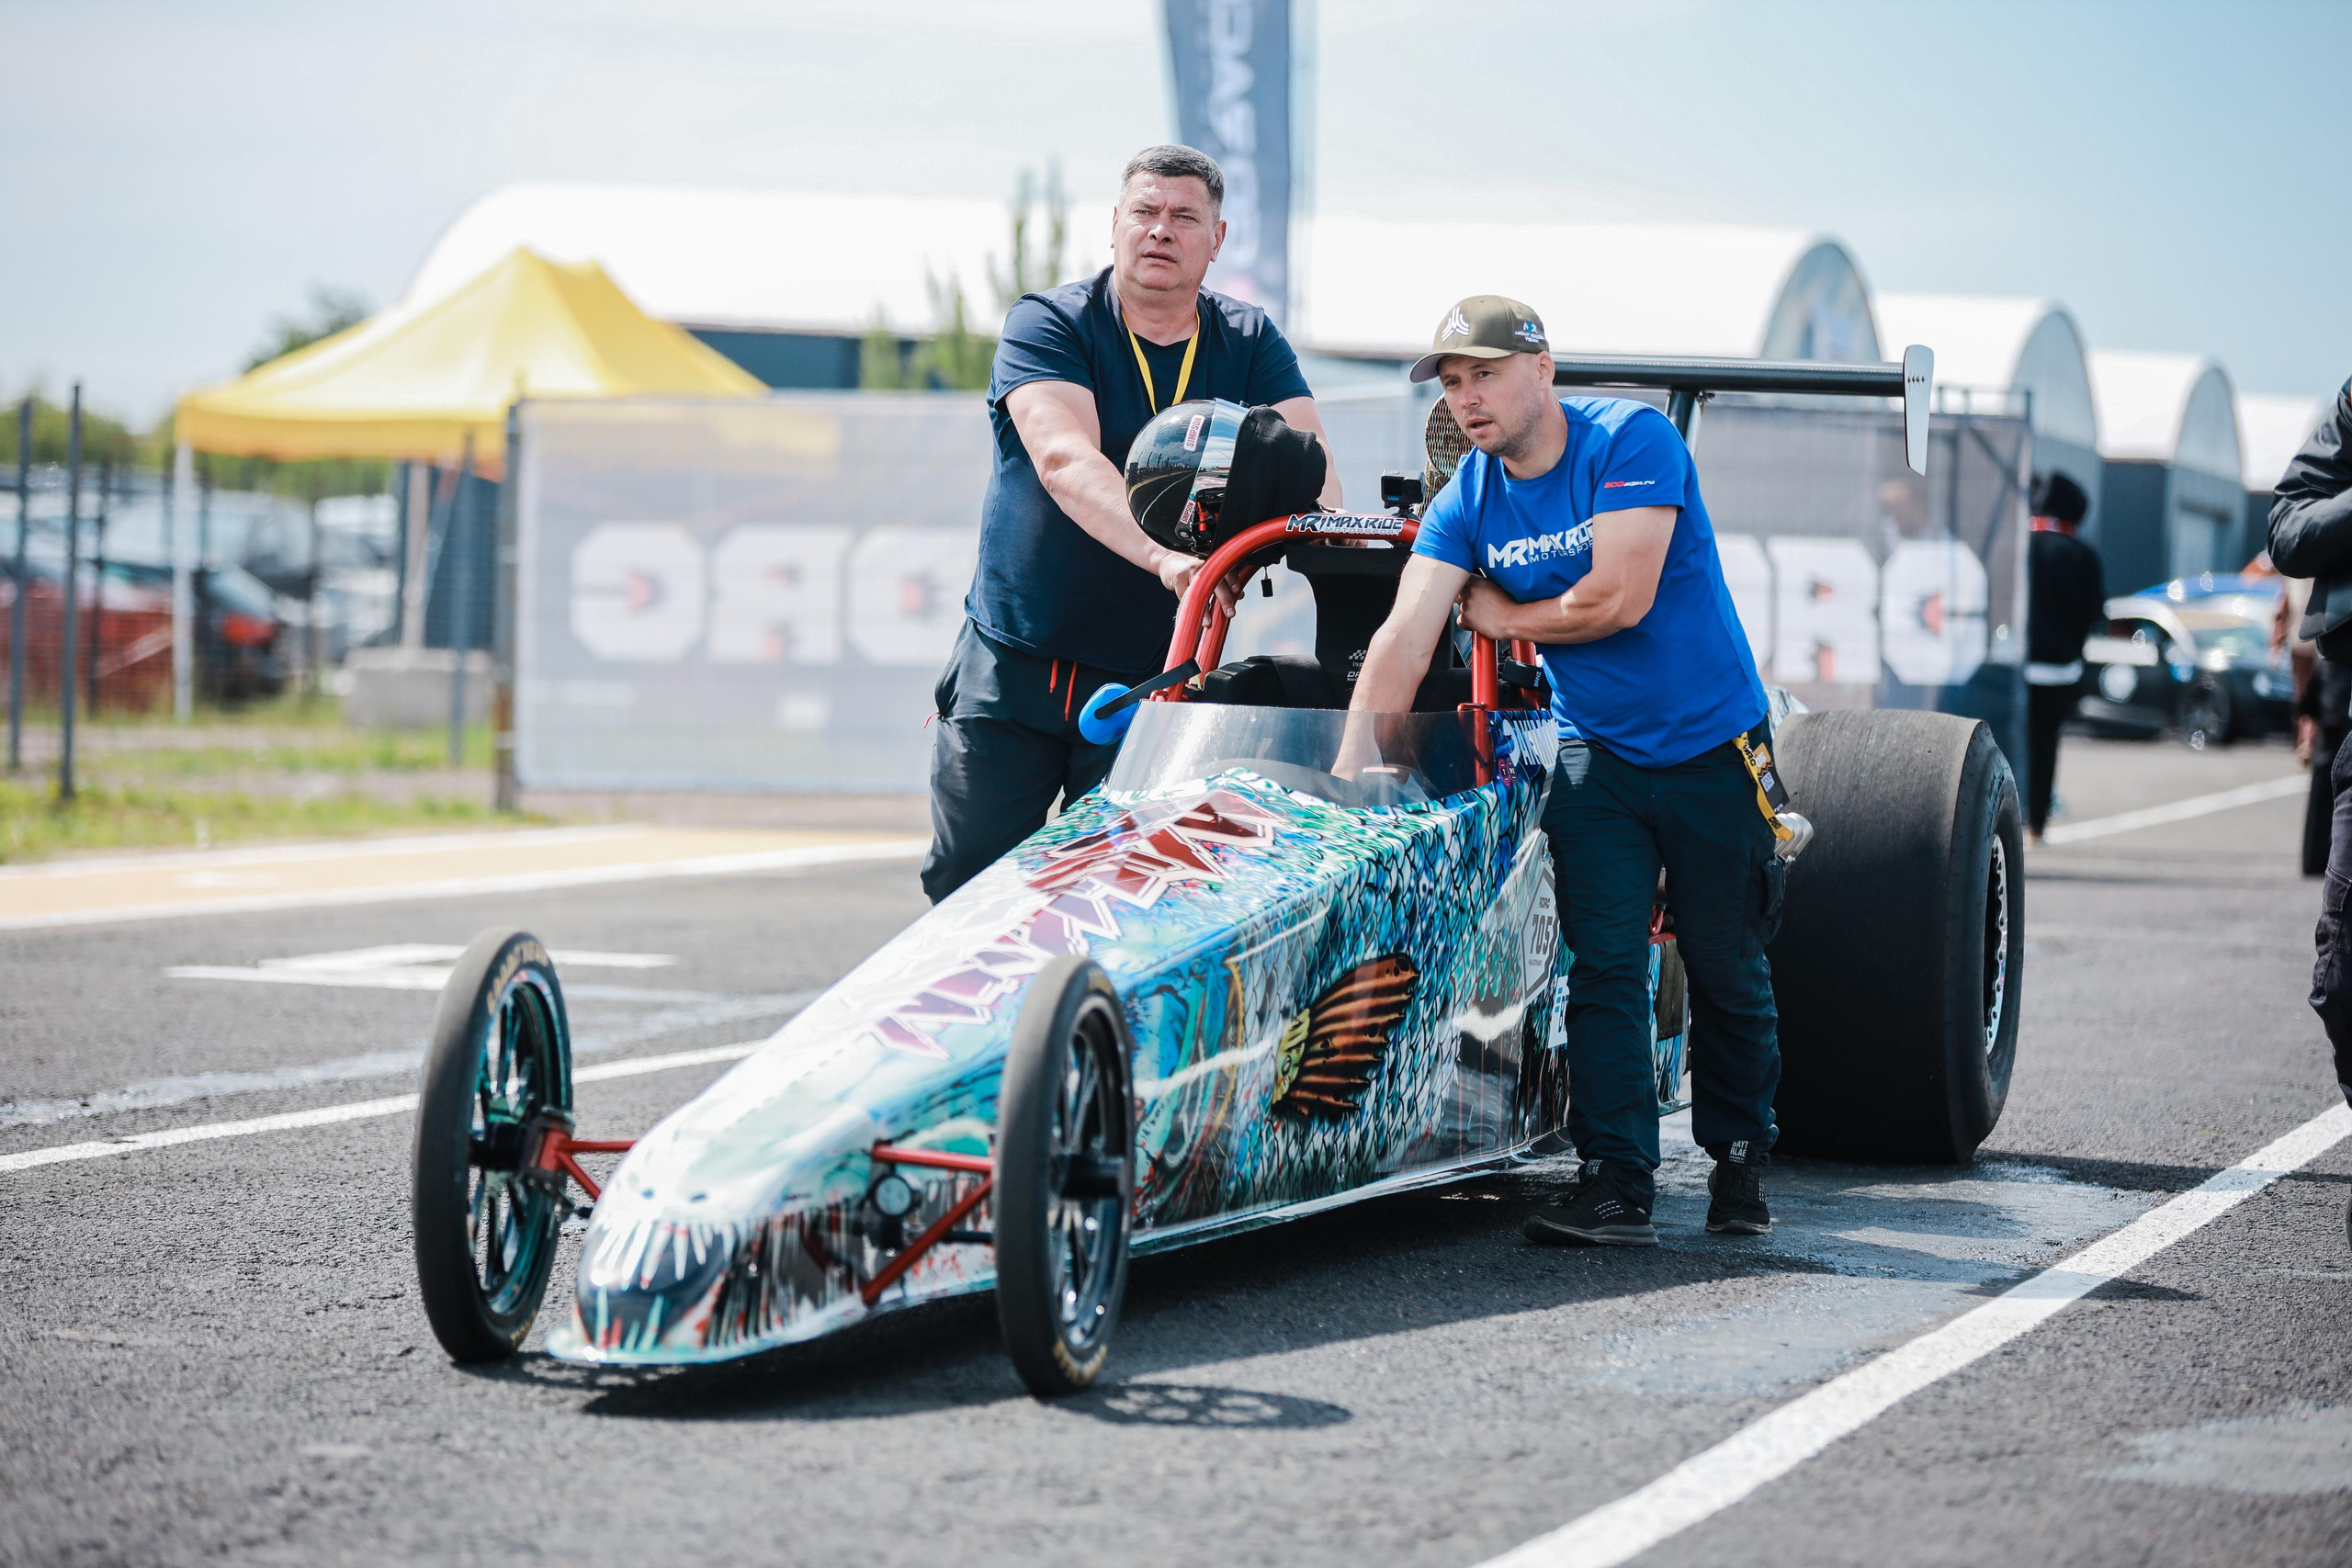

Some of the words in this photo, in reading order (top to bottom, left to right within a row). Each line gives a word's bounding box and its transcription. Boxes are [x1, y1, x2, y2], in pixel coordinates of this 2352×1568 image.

[1187, 417, 1202, 448] SIMPSON
[1182, 502, 1194, 523] SIMPSON
[1287, 515, 1322, 531] MR
[1488, 538, 1528, 568] MR
[1530, 914, 1553, 955] 705
[1732, 1140, 1749, 1149] SAYT
